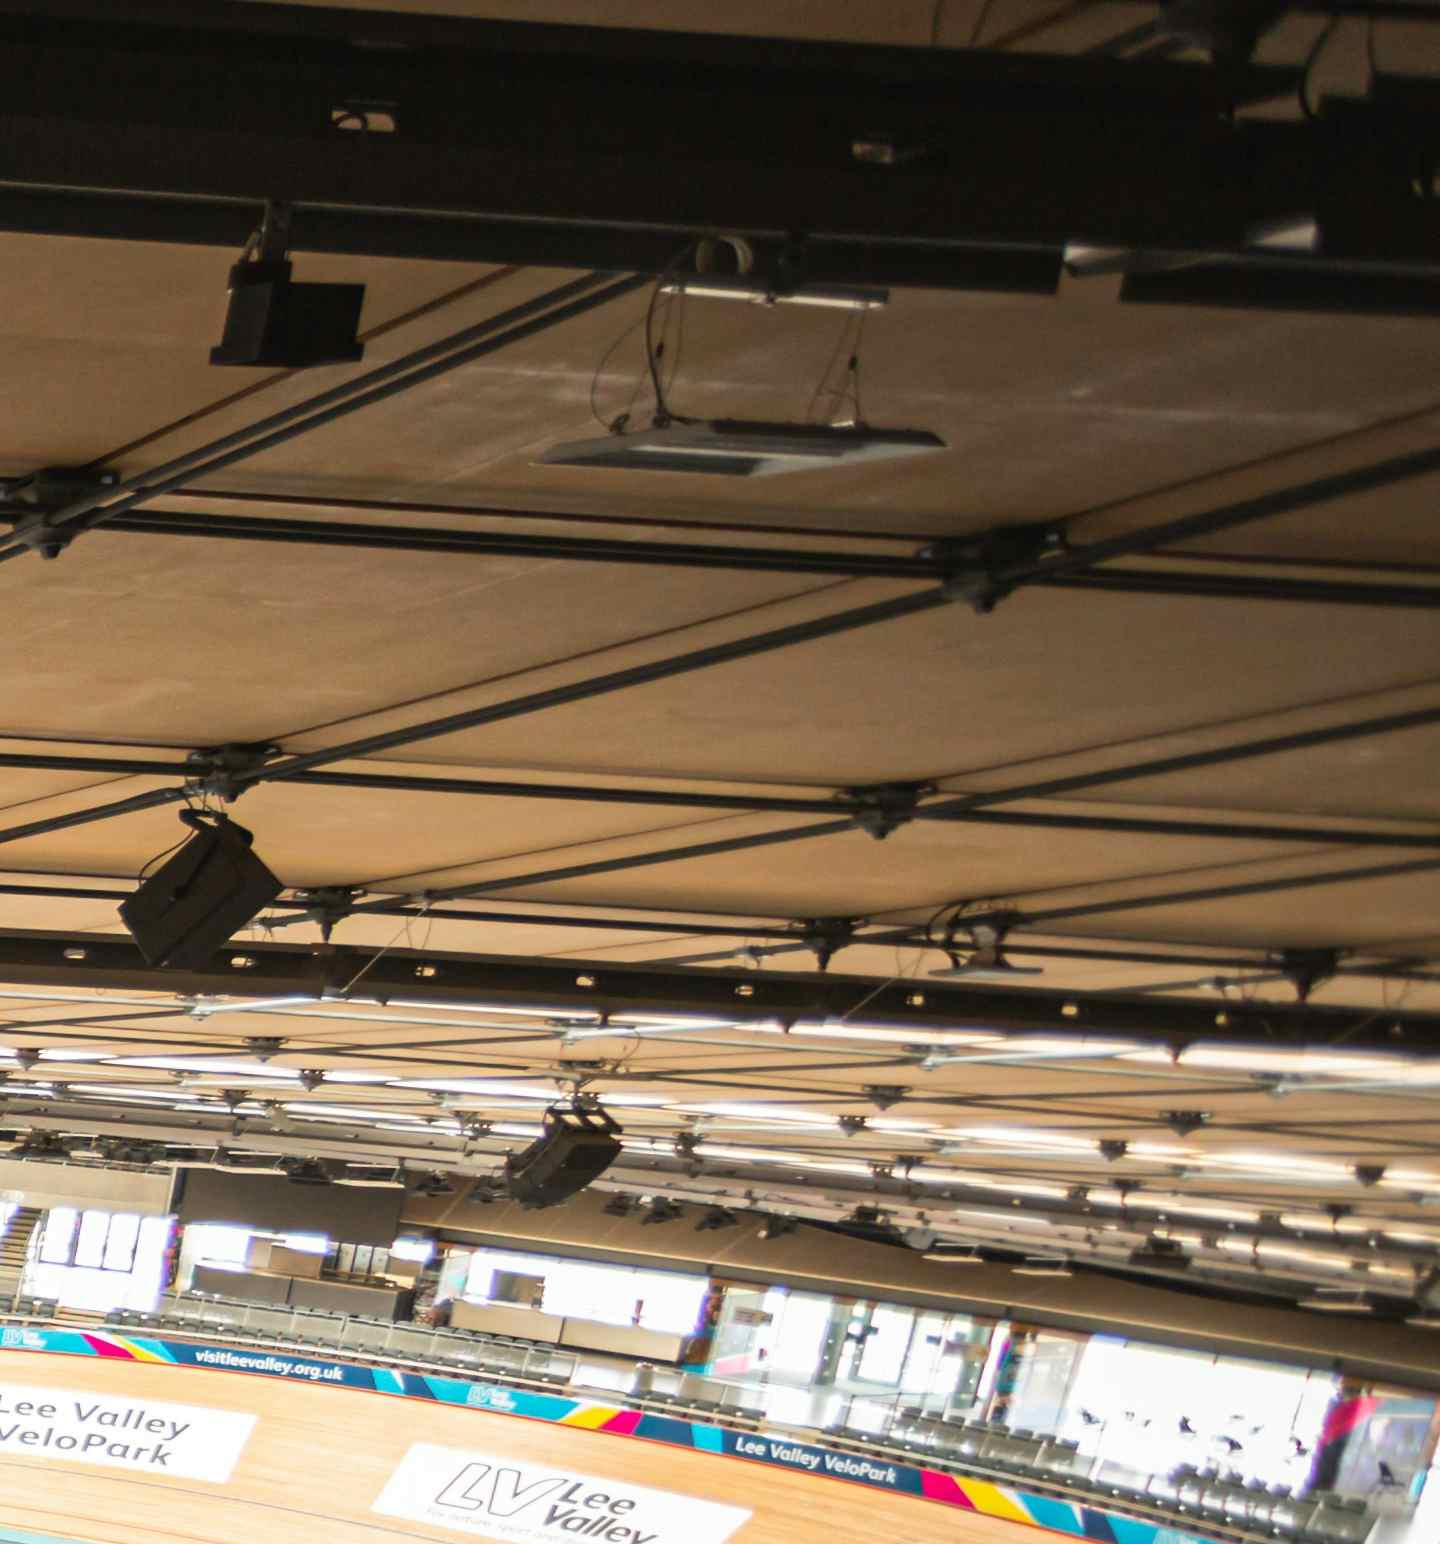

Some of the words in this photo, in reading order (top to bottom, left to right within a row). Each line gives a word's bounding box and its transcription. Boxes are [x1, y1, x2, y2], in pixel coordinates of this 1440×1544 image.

[194, 1349, 343, 1382] visitleevalley.org.uk
[73, 1401, 192, 1442] Valley
[735, 1436, 765, 1456] Lee
[771, 1443, 820, 1469] Valley
[825, 1454, 897, 1484] VeloPark
[556, 1481, 637, 1516] Lee
